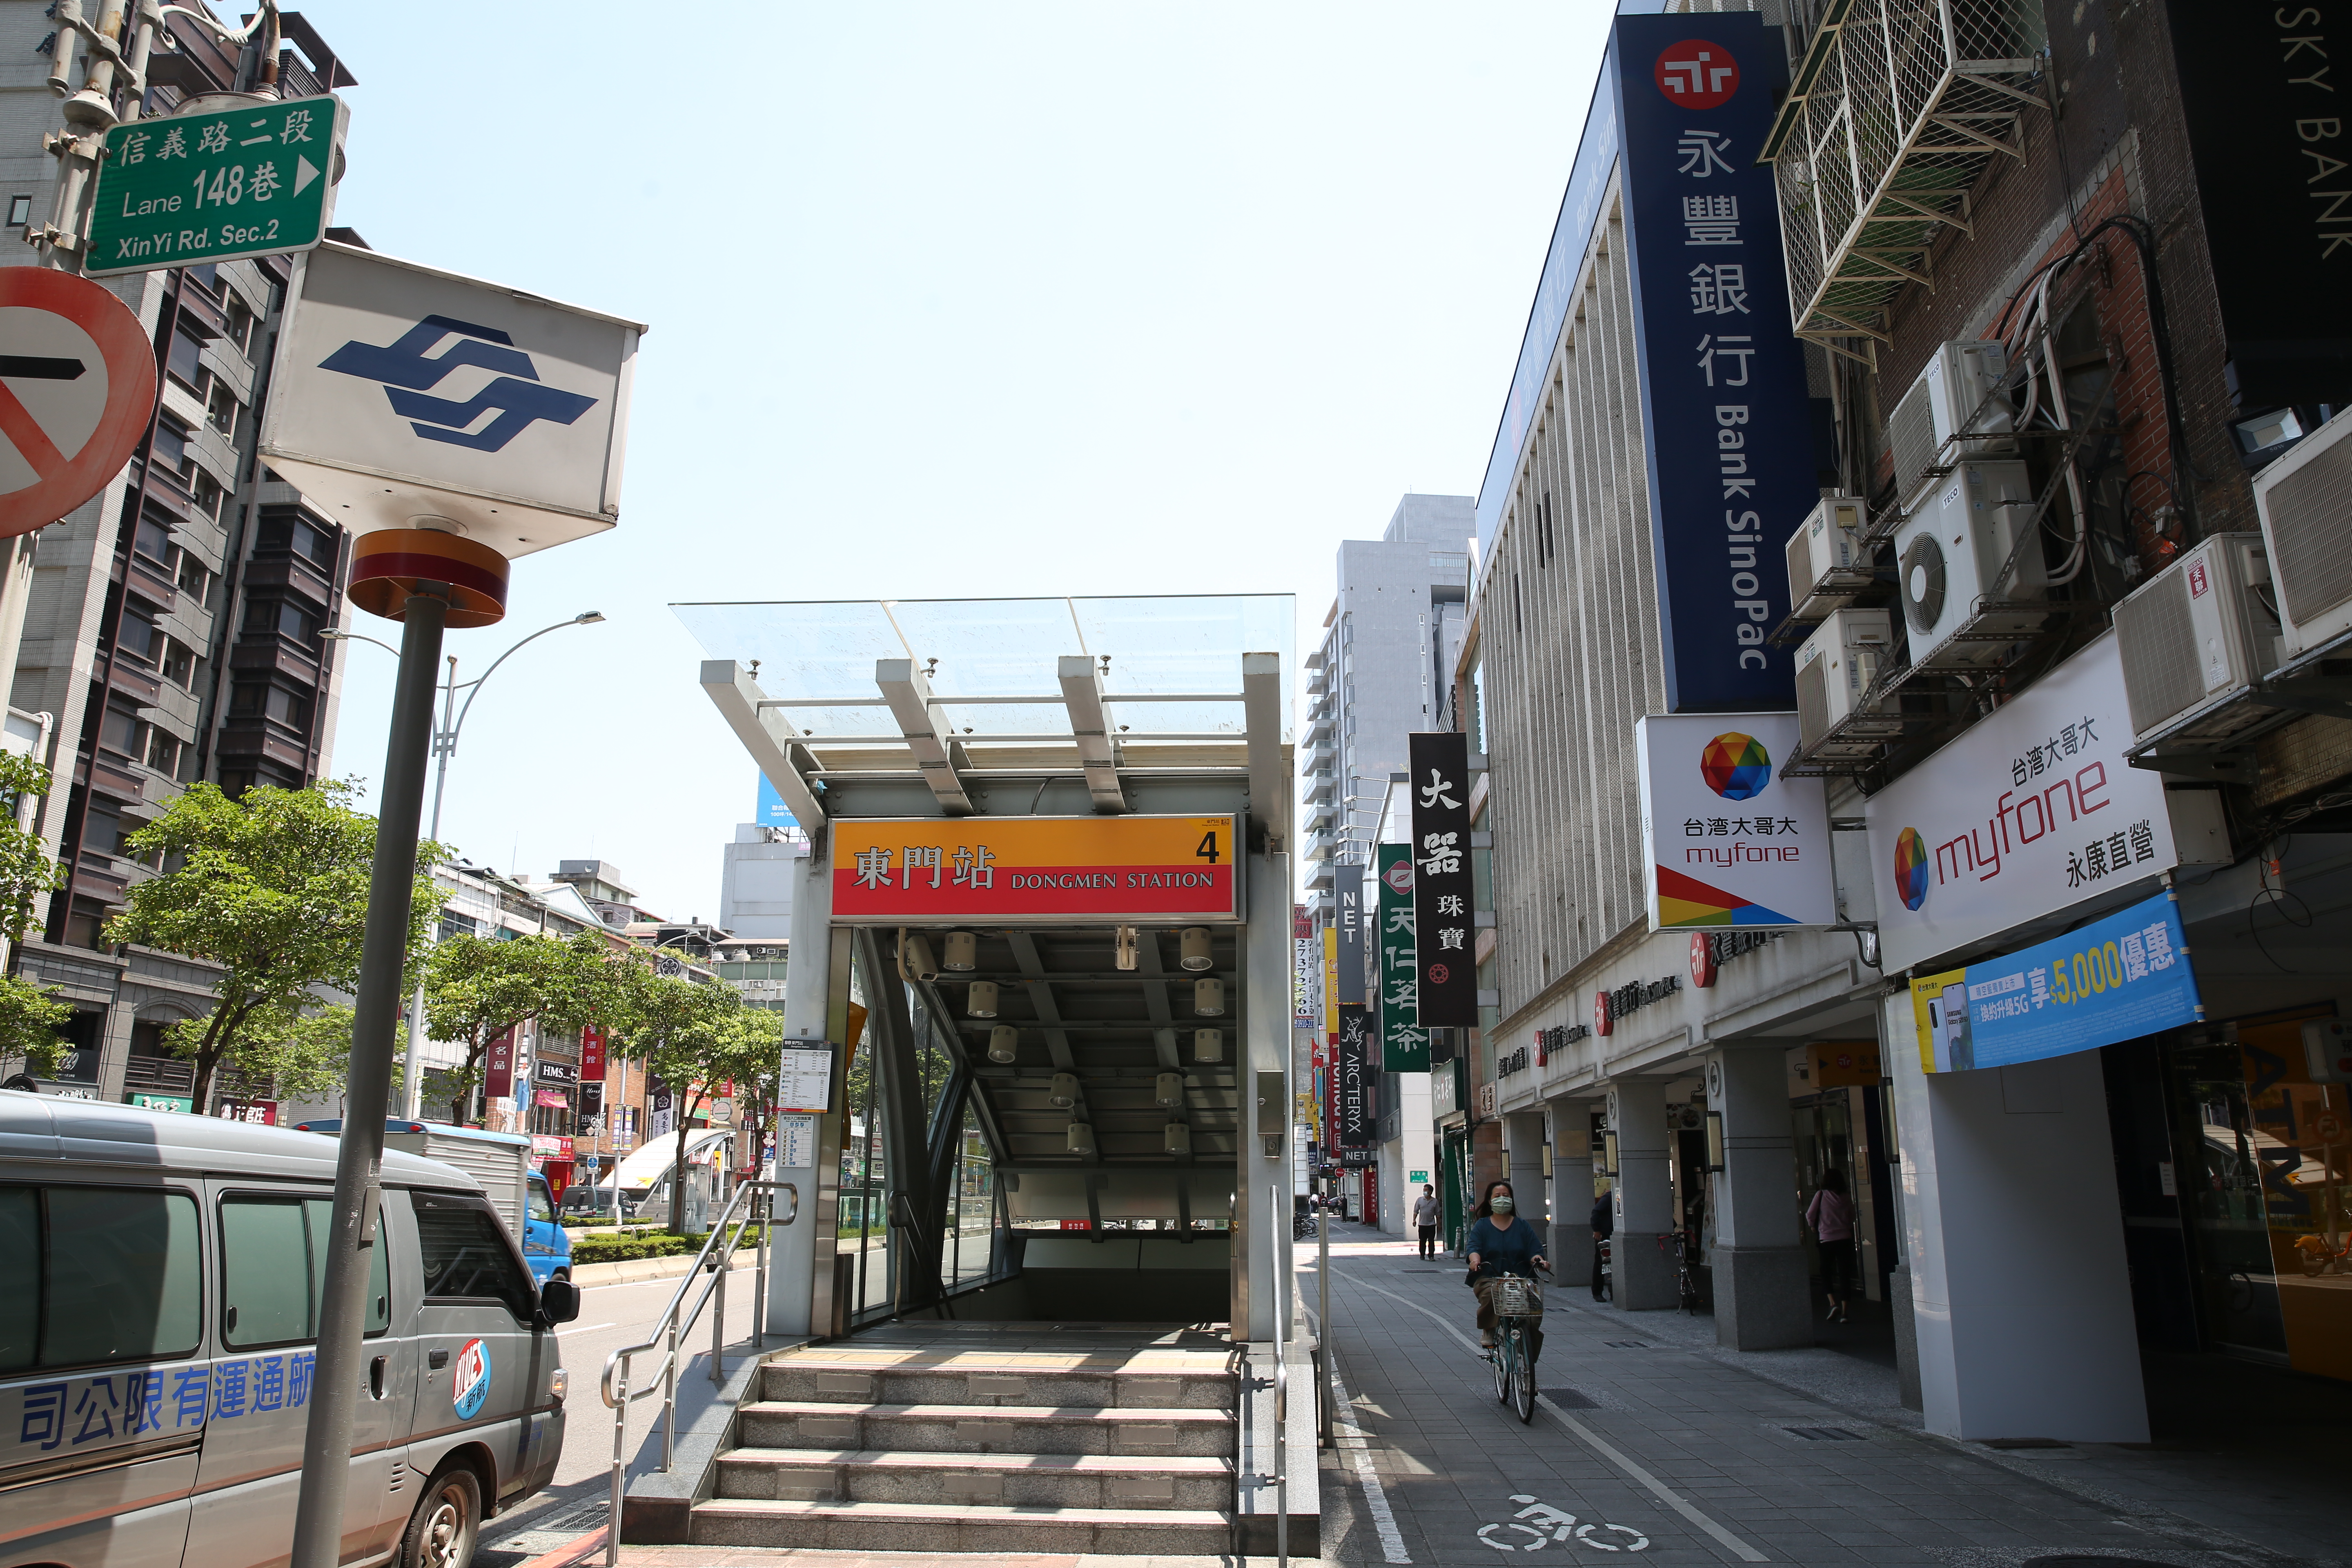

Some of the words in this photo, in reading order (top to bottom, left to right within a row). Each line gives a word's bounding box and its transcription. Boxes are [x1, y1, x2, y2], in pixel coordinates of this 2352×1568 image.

[2275, 7, 2334, 92] SKY
[118, 109, 313, 167] 信義路二段
[122, 193, 182, 218] Lane
[194, 161, 282, 209] 148巷
[1577, 160, 1599, 239] Bank
[2295, 117, 2352, 260] BANK
[117, 233, 172, 258] XinYi
[178, 229, 212, 251] Rd.
[220, 219, 279, 245] Sec.2
[1678, 130, 1755, 387] 永豐銀行
[1929, 363, 1940, 381] TECO
[1715, 405, 1756, 500] Bank
[1944, 488, 1958, 506] TECO
[2188, 558, 2202, 571] HERAN
[2193, 569, 2203, 592] 禾聯
[1726, 509, 1769, 670] SinoPac
[2012, 716, 2099, 787] 台湾大哥大
[1683, 816, 1798, 837] 台湾大哥大
[1936, 761, 2110, 885] myfone
[852, 845, 996, 890] 東門站
[1196, 831, 1220, 864] 4
[1686, 842, 1800, 868] myfone
[2067, 819, 2155, 889] 永康直營
[1011, 873, 1117, 889] DONGMEN
[1127, 871, 1214, 889] STATION
[1343, 892, 1356, 944] NET
[1606, 980, 1639, 1022] 永豐銀行
[1638, 986, 1651, 1005] Bank
[1651, 976, 1675, 1000] SinoPac
[1980, 993, 2029, 1022] 換約升級5G
[543, 1065, 564, 1078] HMS
[1346, 1053, 1361, 1133] ARC'TERYX
[2243, 1043, 2311, 1215] ATM
[1345, 1152, 1368, 1160] NET
[466, 1379, 486, 1413] 新航
